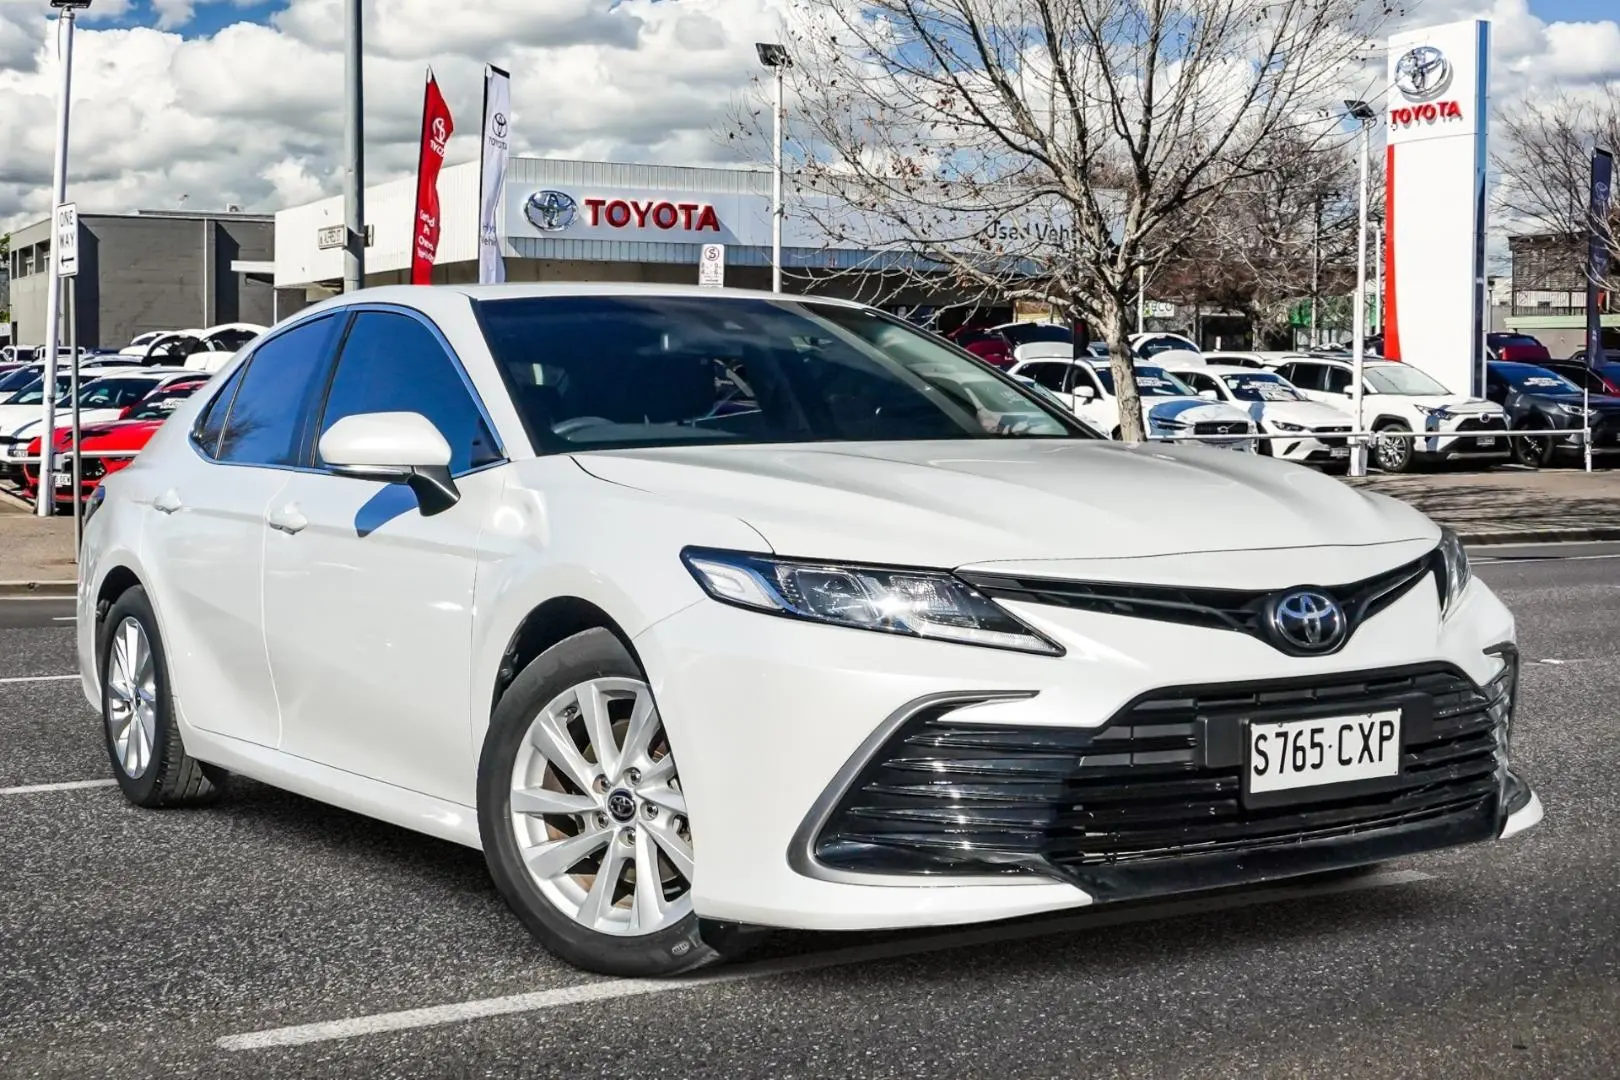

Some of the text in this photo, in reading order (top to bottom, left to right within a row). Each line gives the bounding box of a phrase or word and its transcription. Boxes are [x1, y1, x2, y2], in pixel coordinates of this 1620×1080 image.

[1389, 100, 1463, 125] TOYOTA
[59, 210, 73, 227] ONE
[585, 199, 720, 231] TOYOTA
[59, 231, 75, 248] WAY
